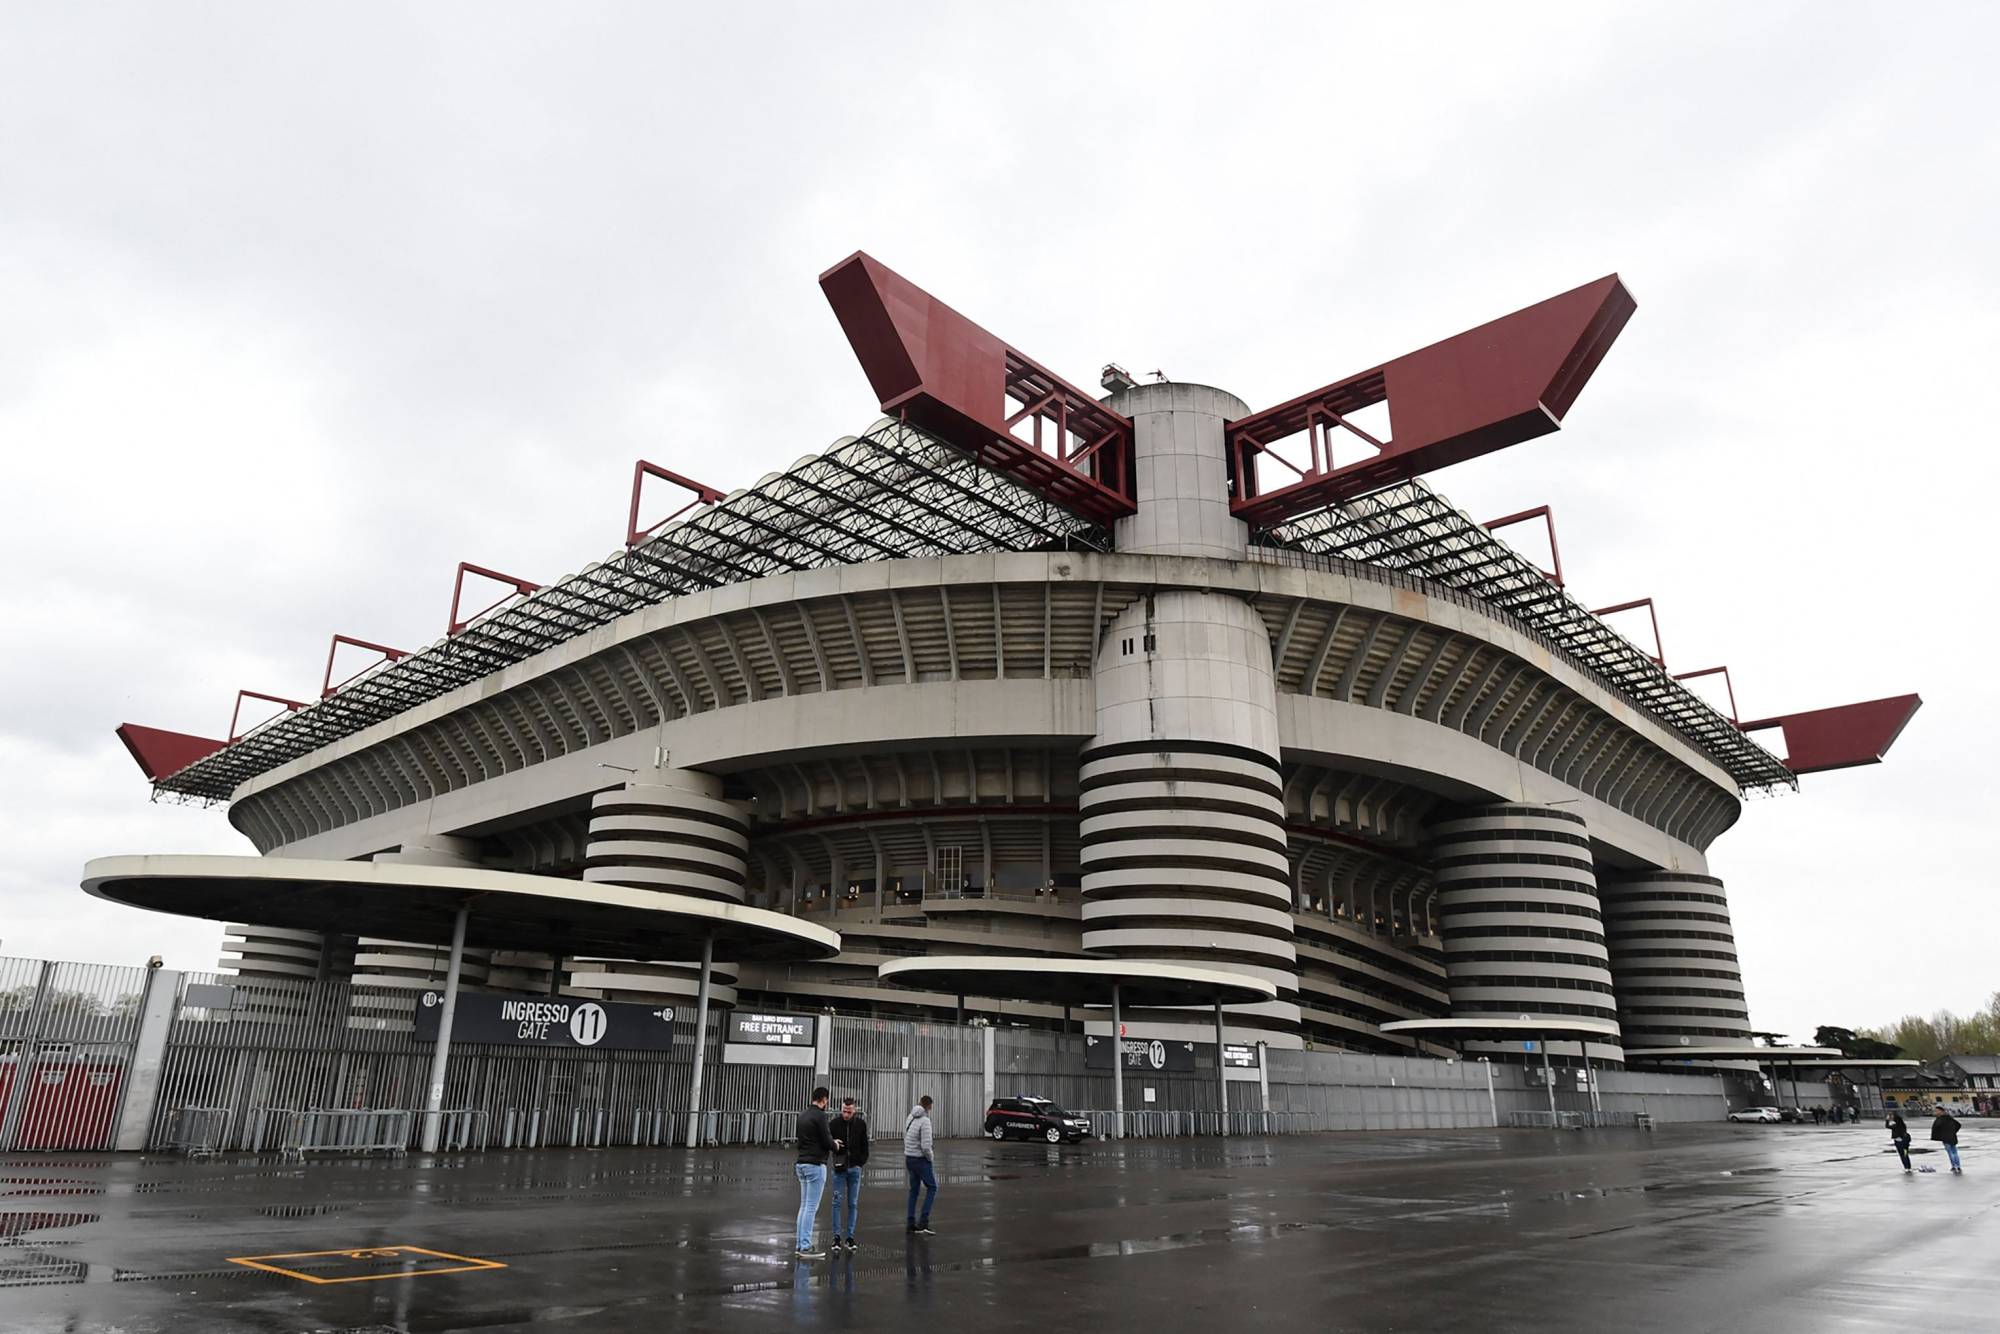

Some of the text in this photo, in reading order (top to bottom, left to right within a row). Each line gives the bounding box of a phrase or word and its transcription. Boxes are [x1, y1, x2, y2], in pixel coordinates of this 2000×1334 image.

[426, 994, 435, 1005] 10
[502, 1001, 569, 1023] INGRESSO
[518, 1021, 550, 1039] GATE
[578, 1008, 600, 1040] 11
[740, 1022, 804, 1035] FREE ENTRANCE
[766, 1034, 781, 1042] GATE
[1128, 1054, 1142, 1065] GATE
[1152, 1044, 1163, 1065] 12
